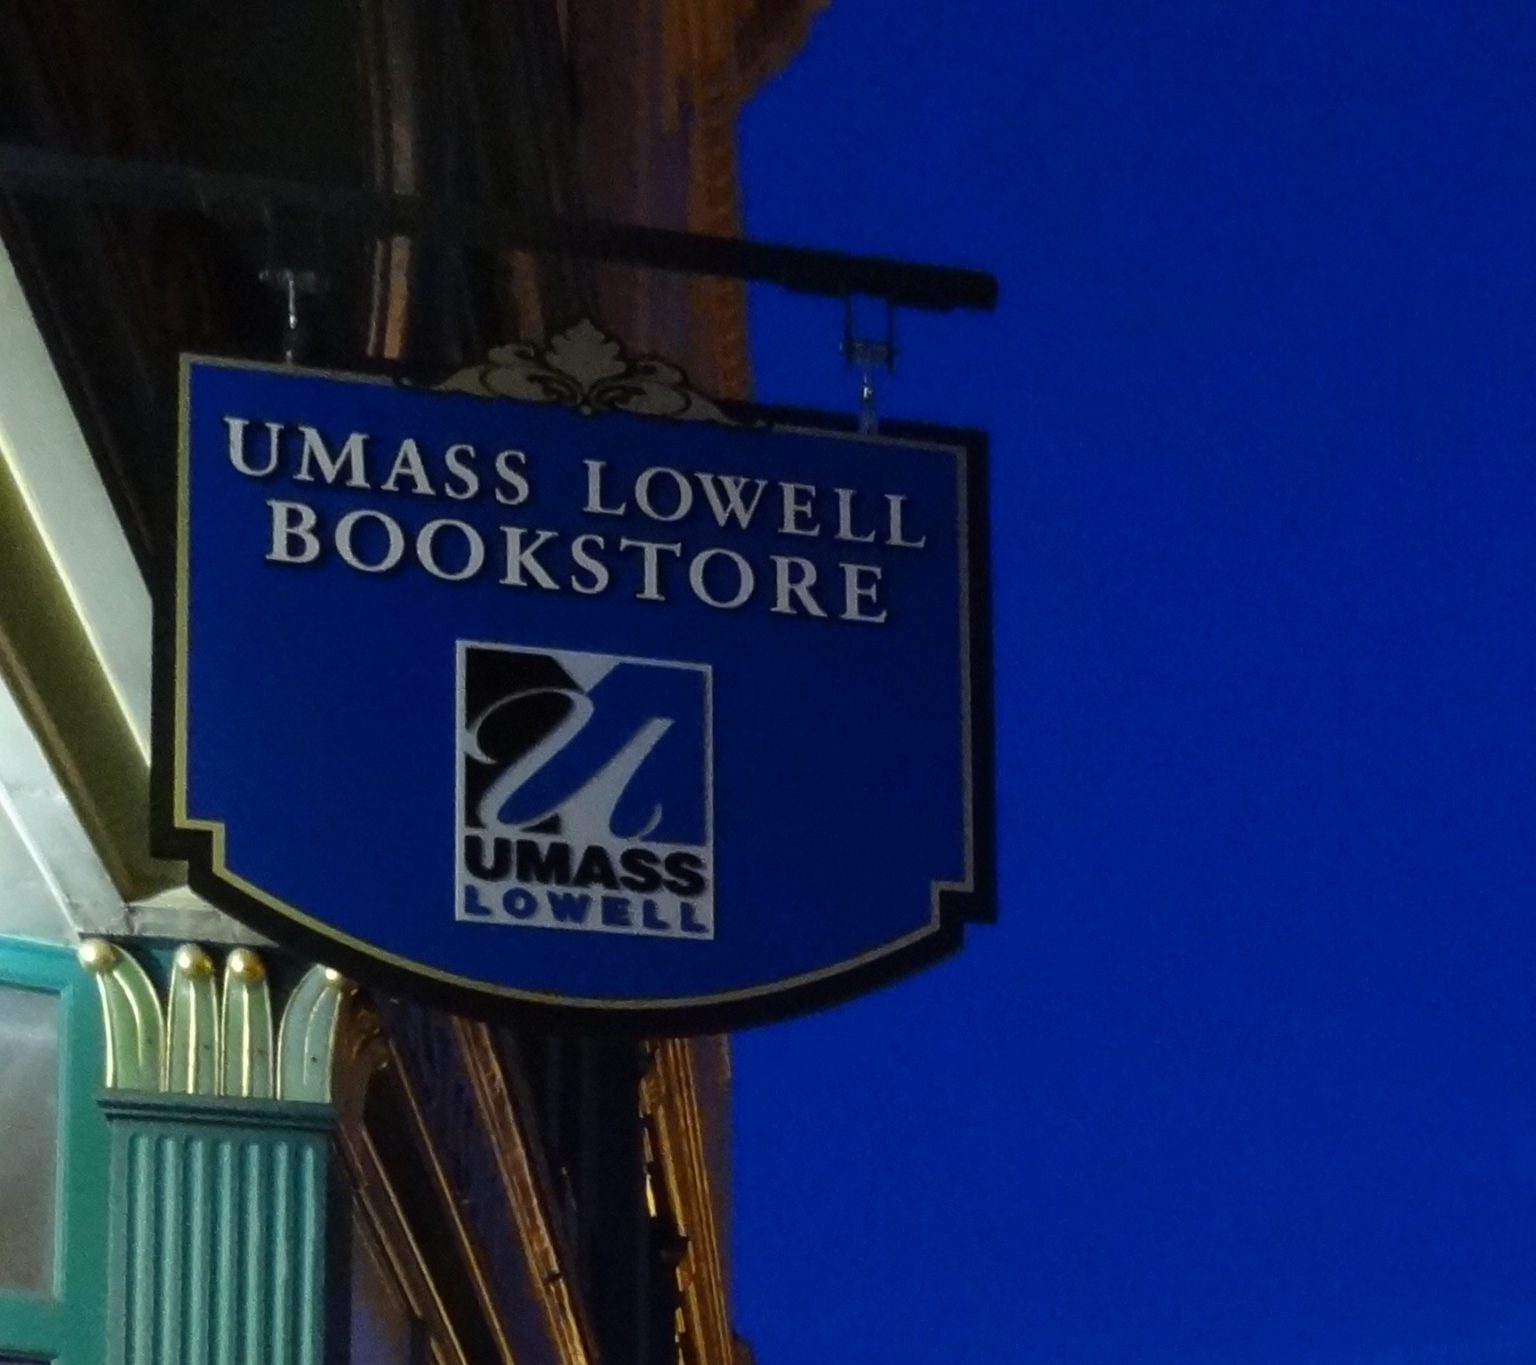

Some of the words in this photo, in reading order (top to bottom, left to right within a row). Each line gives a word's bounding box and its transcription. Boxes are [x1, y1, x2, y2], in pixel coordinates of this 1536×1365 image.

[224, 416, 531, 506] UMASS
[582, 459, 927, 550] LOWELL
[265, 498, 890, 625] BOOKSTORE
[463, 834, 707, 898] UMASS
[463, 888, 708, 935] LOWELL
